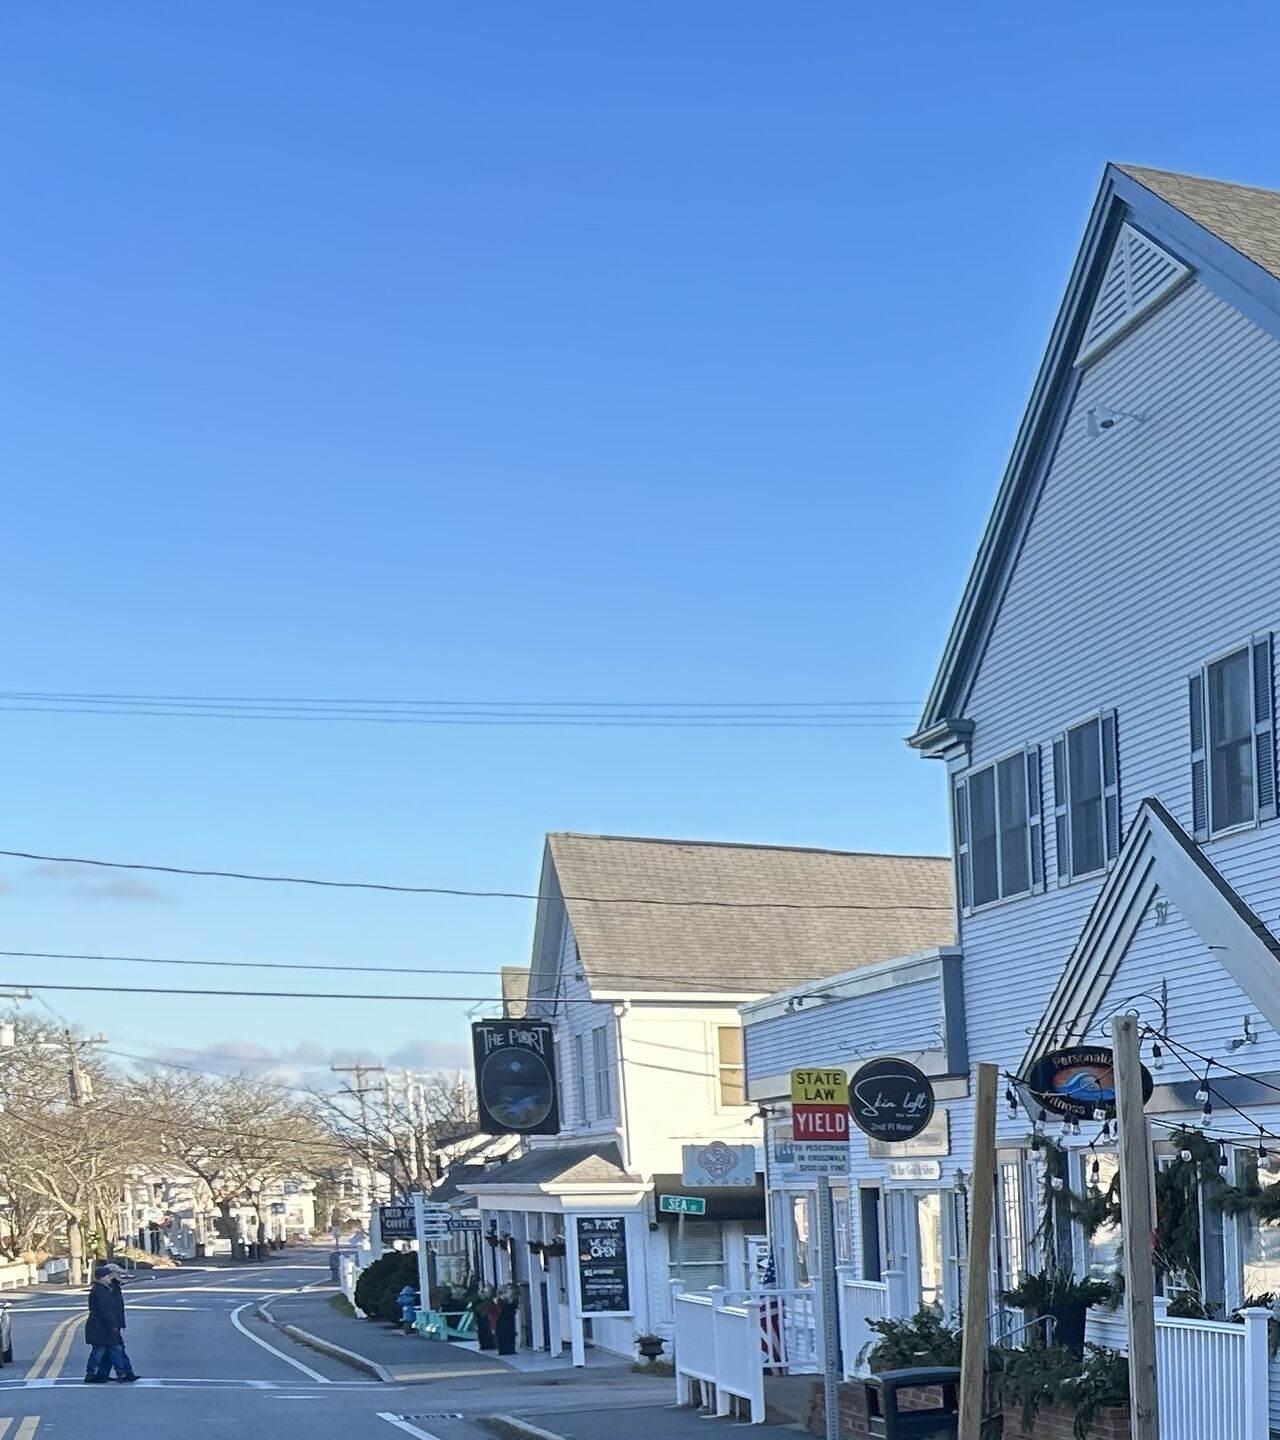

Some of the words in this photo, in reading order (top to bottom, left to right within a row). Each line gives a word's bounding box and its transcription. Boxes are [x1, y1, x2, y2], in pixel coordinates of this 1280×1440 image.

[476, 1026, 505, 1056] THE
[508, 1027, 549, 1055] PORT
[1052, 1053, 1113, 1068] Personaliz
[796, 1072, 841, 1086] STATE
[804, 1089, 835, 1101] LAW
[796, 1113, 845, 1133] YIELD
[668, 1198, 687, 1211] SEA
[590, 1246, 616, 1258] OPEN
